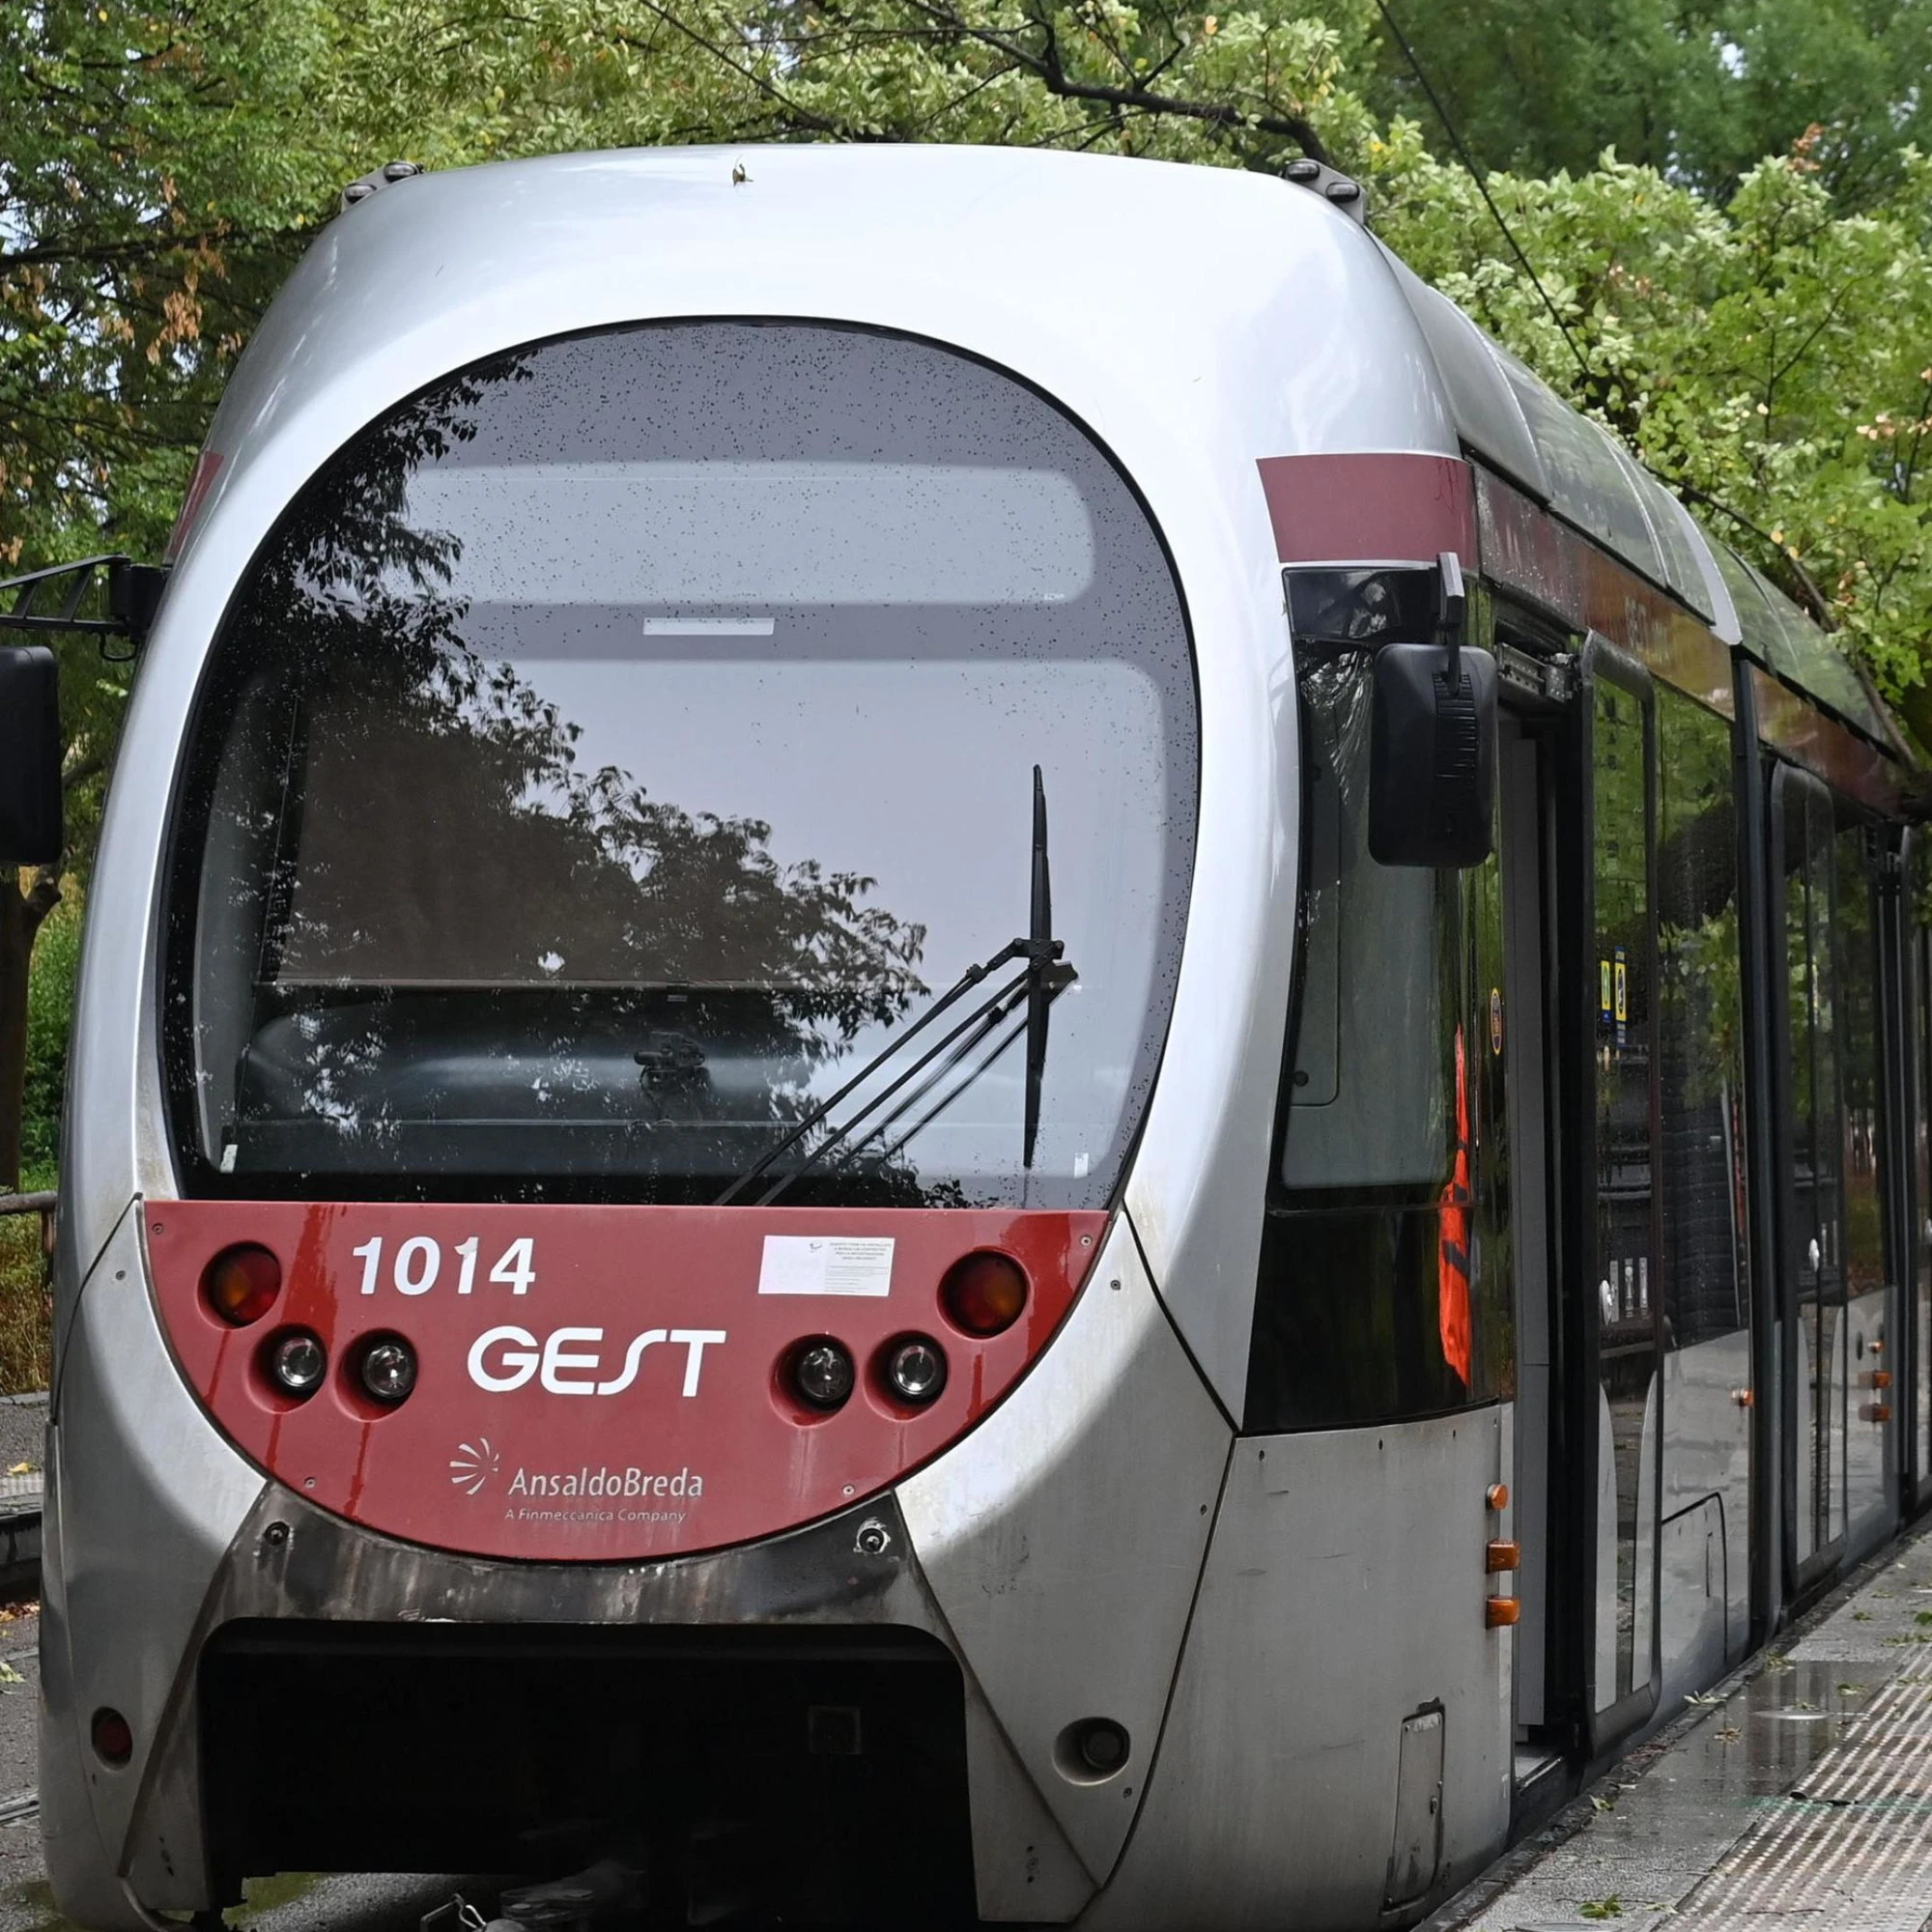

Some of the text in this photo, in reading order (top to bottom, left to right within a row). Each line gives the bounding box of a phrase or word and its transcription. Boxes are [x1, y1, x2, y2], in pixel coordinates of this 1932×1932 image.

[352, 1236, 537, 1296] 1014
[467, 1325, 727, 1398] GEST
[507, 1466, 704, 1497] AnsaldoBreda
[505, 1508, 687, 1524] A Finmeccanica Company
